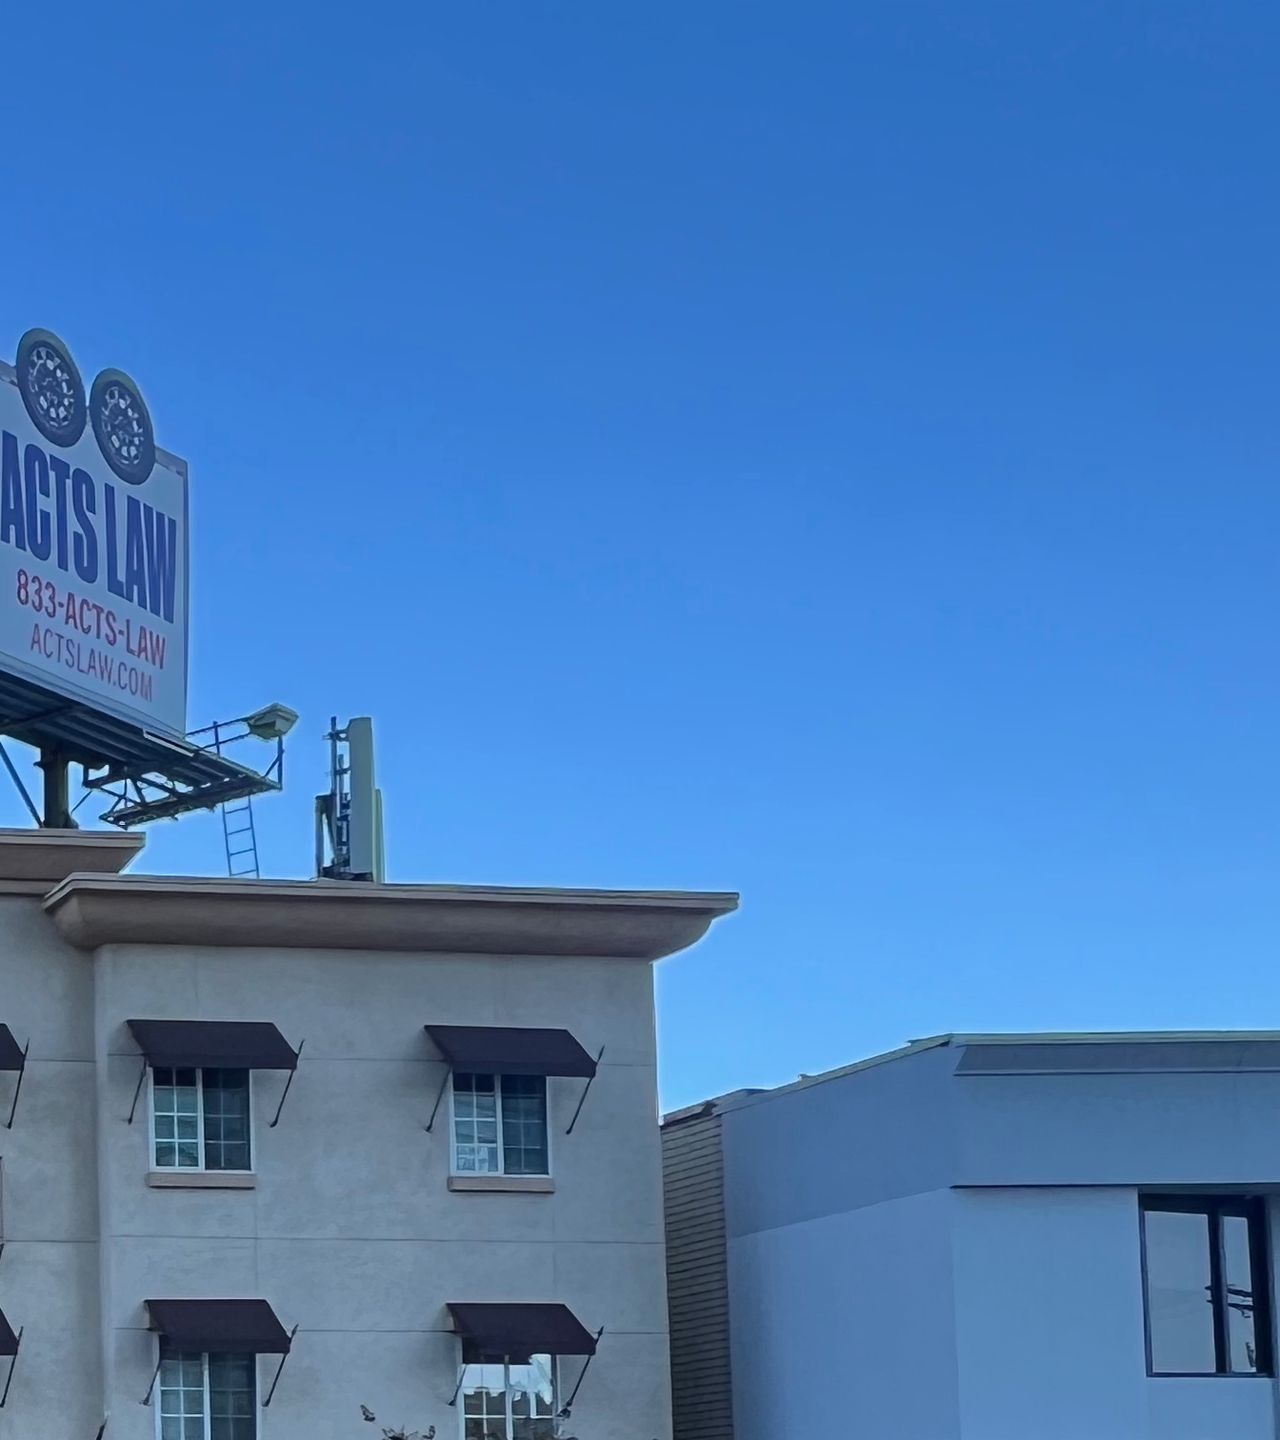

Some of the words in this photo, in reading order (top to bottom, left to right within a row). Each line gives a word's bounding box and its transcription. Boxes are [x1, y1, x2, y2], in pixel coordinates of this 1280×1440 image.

[0, 429, 98, 584] ACTS
[104, 482, 177, 624] LAW
[16, 568, 166, 670] 833-ACTS-LAW
[30, 623, 153, 702] ACTSLAW.COM
